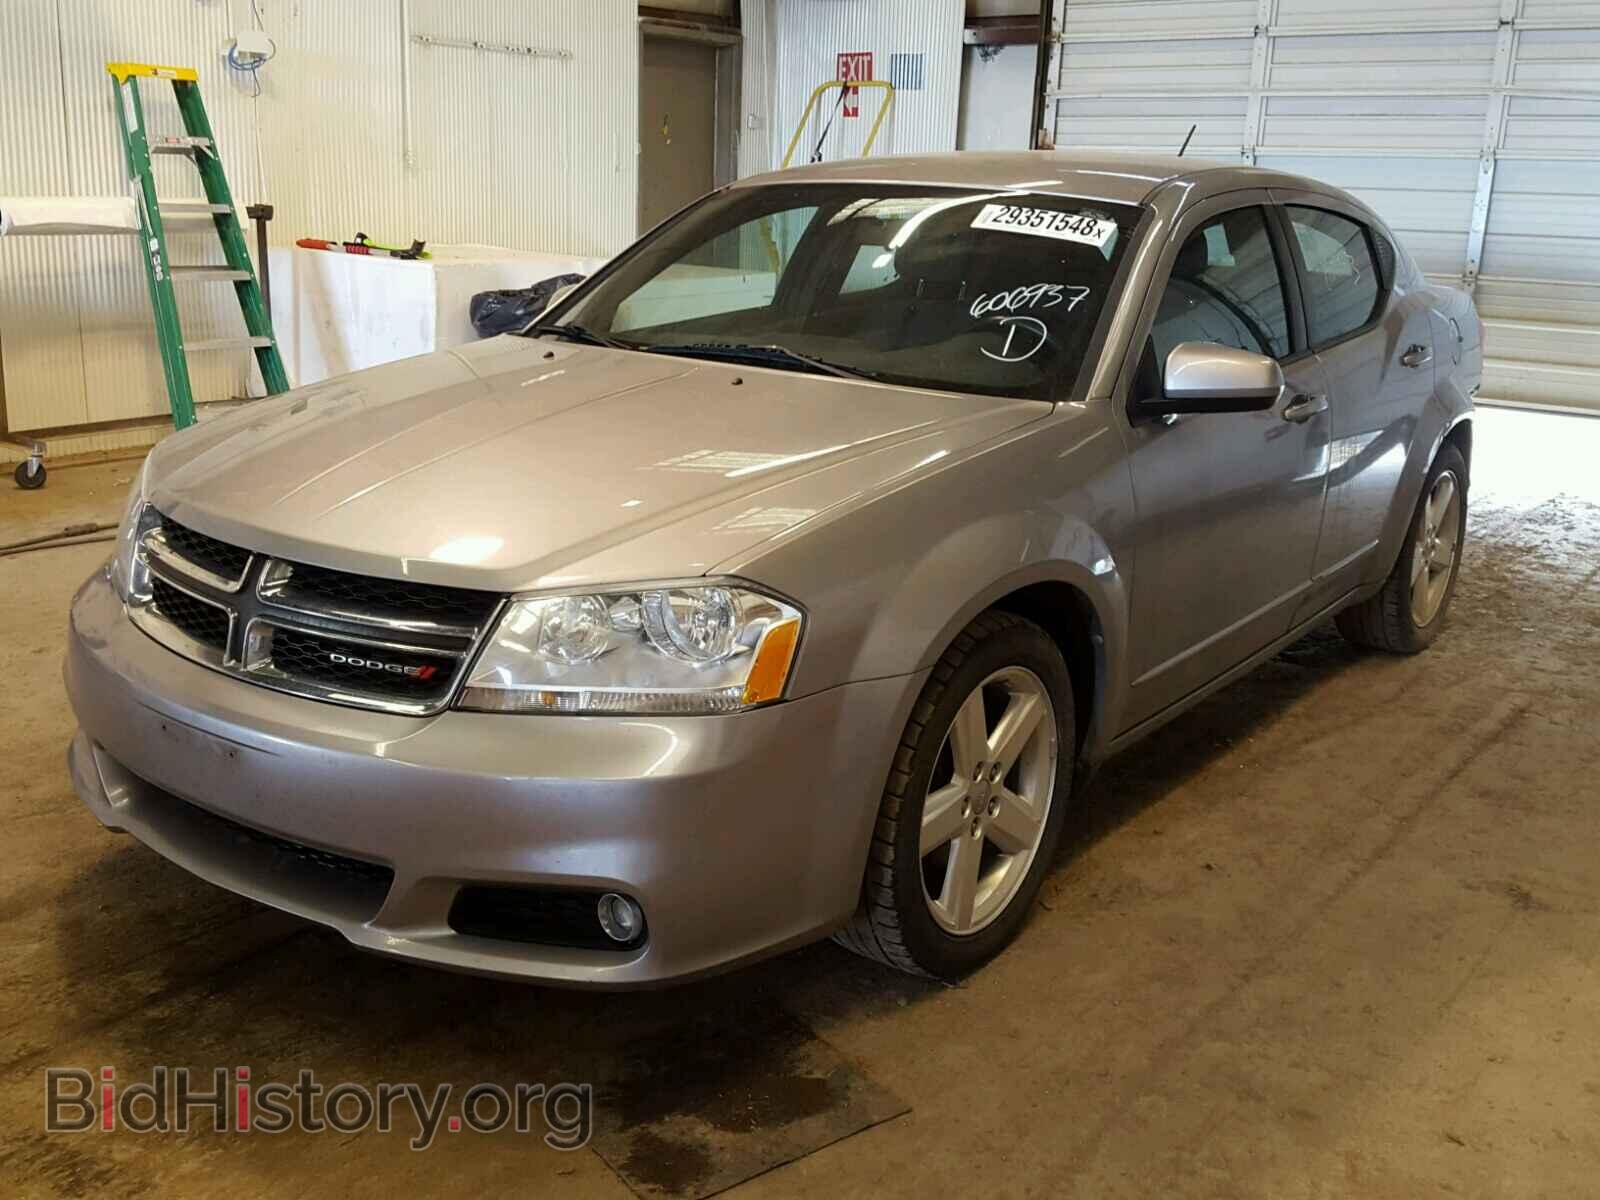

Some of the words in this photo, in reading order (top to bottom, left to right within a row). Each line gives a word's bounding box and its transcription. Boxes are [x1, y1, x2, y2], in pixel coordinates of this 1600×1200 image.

[839, 55, 872, 81] EXIT
[981, 316, 1047, 362] D
[329, 653, 420, 676] DODGE
